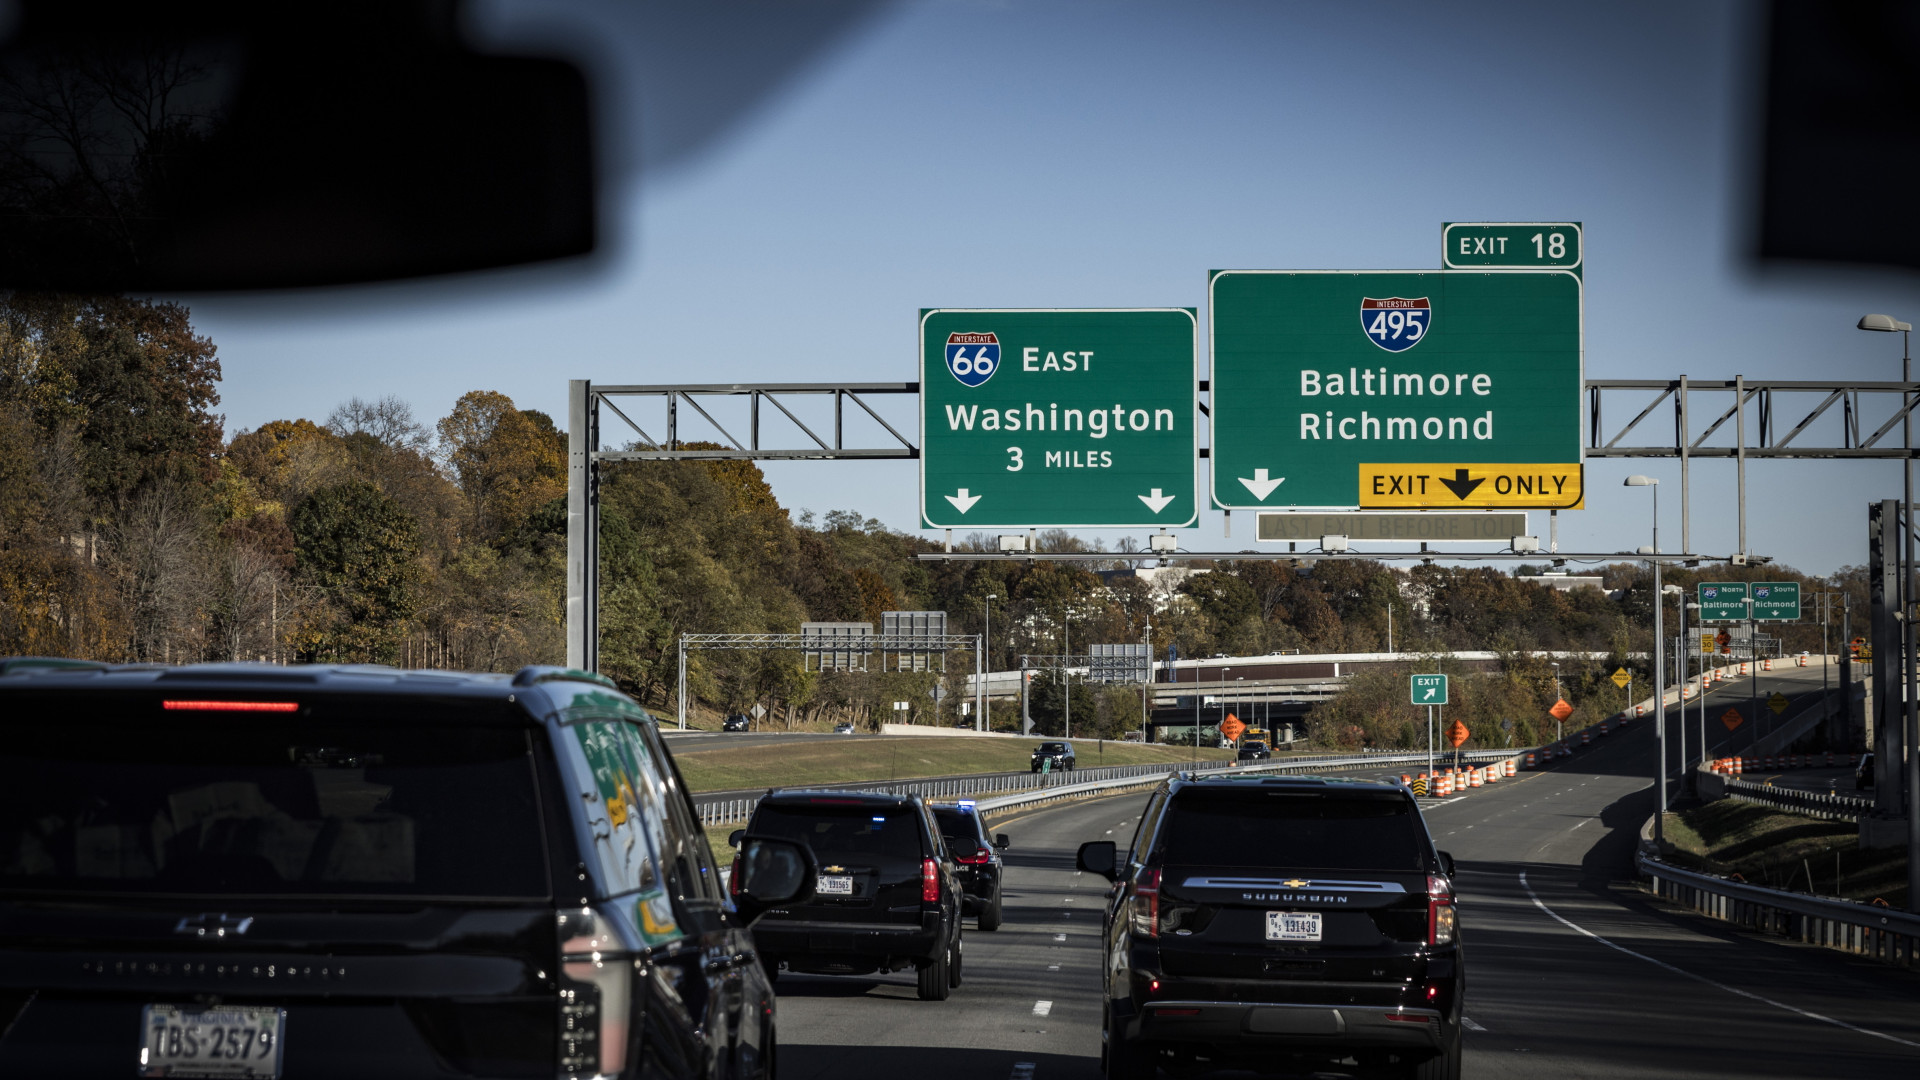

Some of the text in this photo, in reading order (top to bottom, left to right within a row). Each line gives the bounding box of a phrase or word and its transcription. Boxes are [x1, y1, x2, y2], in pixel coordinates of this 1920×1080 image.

[1460, 233, 1566, 259] EXIT 18
[1376, 300, 1415, 309] INTERSTATE
[1368, 310, 1424, 341] 495
[953, 335, 992, 344] INTERSTATE
[952, 346, 995, 376] 66
[1022, 346, 1094, 372] EAST
[1300, 367, 1492, 396] Baltimore
[945, 402, 1174, 439] Washington
[1300, 410, 1493, 440] Richmond
[1006, 446, 1113, 472] 3 MILES
[1372, 474, 1568, 495] EXIT ONLY
[1262, 517, 1312, 537] LAST
[1323, 516, 1368, 536] EXIT
[1379, 516, 1459, 537] BEFORE
[1242, 893, 1348, 903] SUBURBAN
[1285, 920, 1317, 933] 131439
